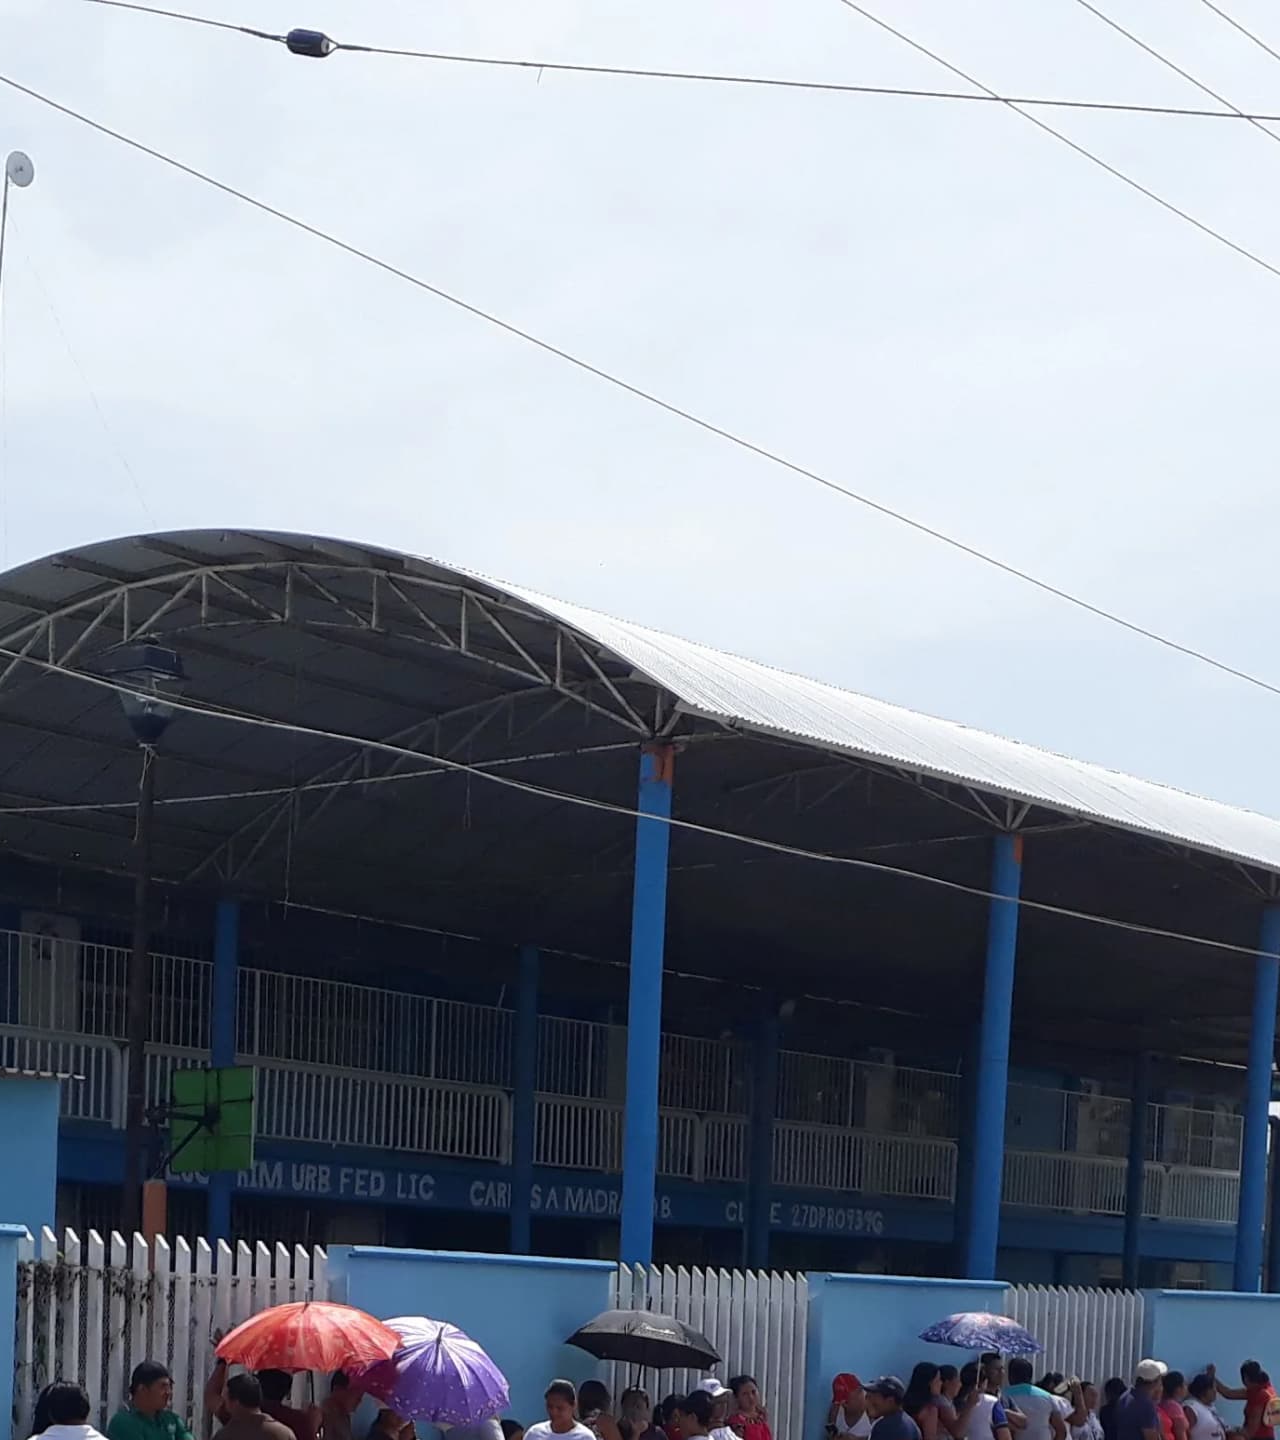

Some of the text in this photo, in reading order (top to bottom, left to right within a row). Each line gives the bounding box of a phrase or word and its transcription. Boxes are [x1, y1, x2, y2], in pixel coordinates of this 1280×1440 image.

[291, 1163, 331, 1192] URB
[339, 1167, 385, 1197] FED
[396, 1171, 435, 1200] LIC
